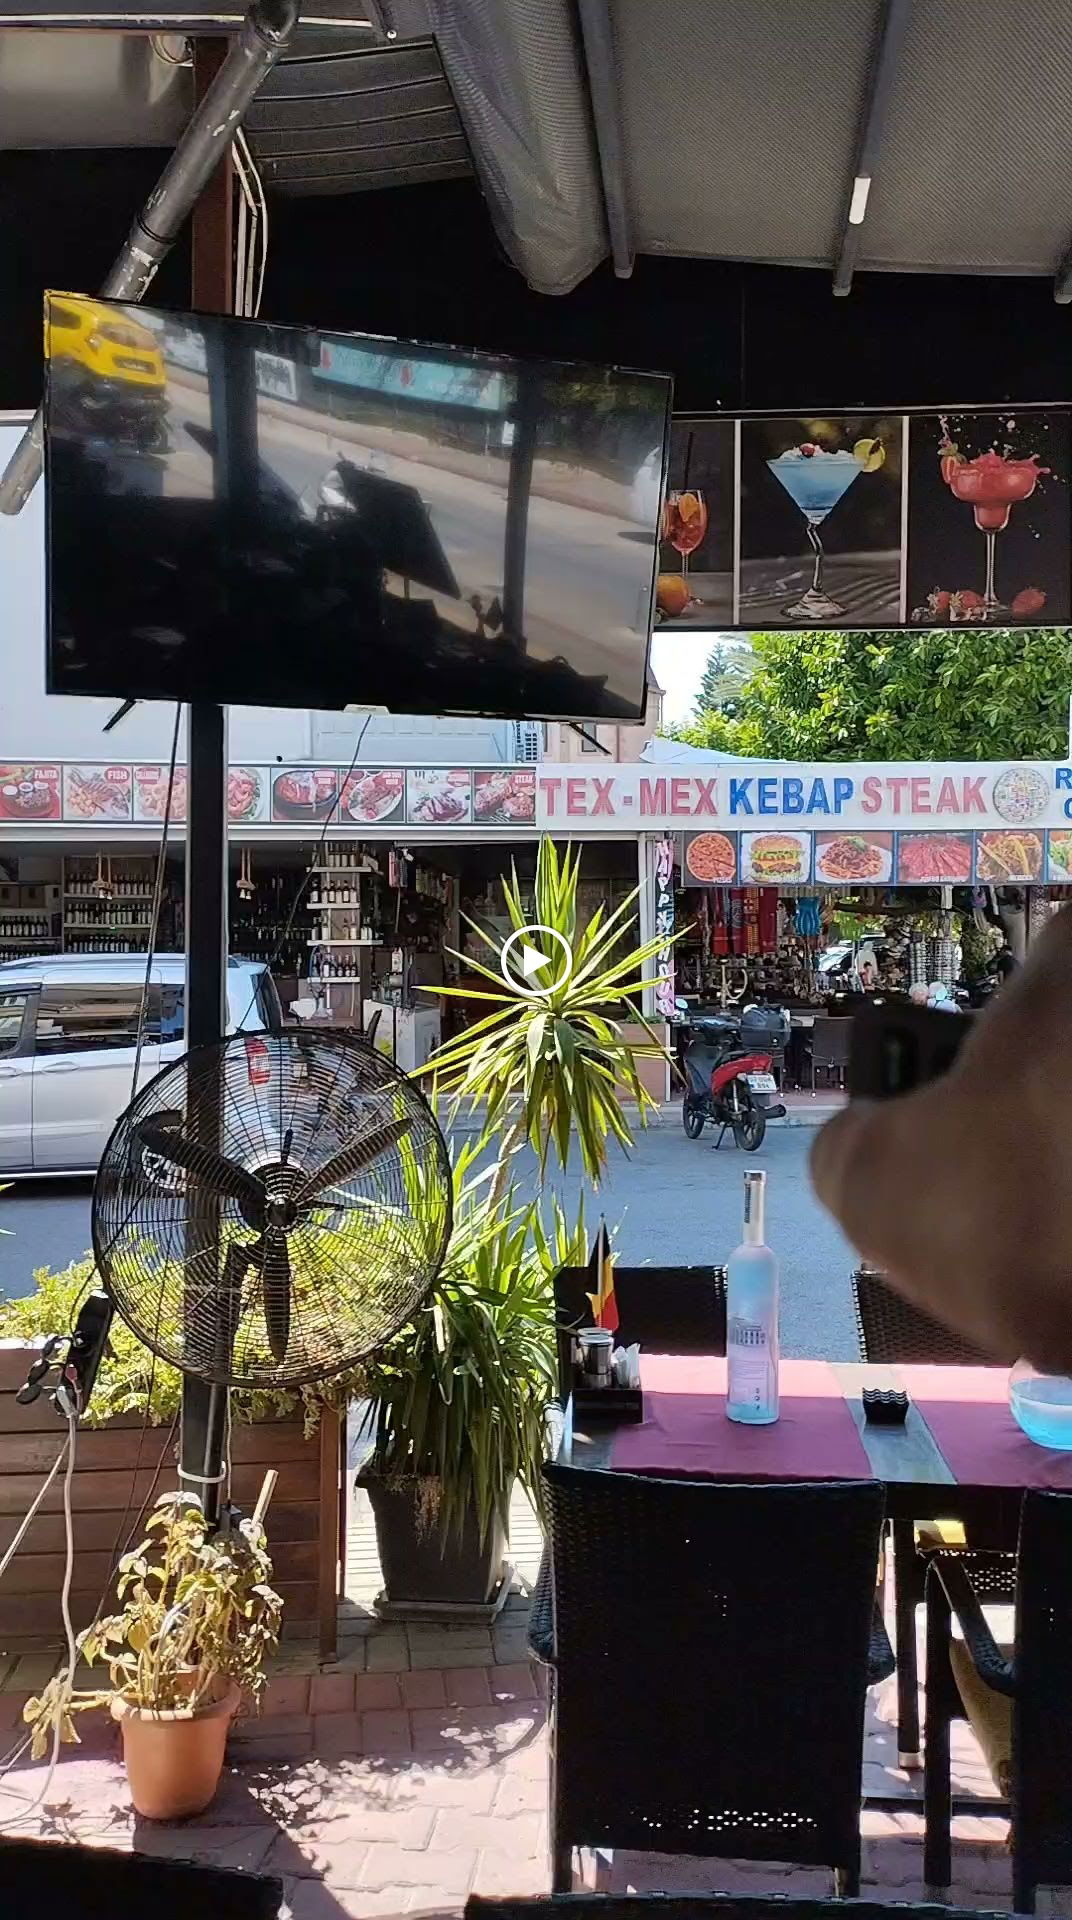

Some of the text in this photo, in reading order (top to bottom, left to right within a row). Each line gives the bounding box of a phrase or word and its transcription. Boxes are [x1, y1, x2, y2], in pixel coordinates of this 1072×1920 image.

[107, 770, 128, 780] FISH
[729, 777, 854, 815] KEBAP
[861, 776, 988, 814] STEAK
